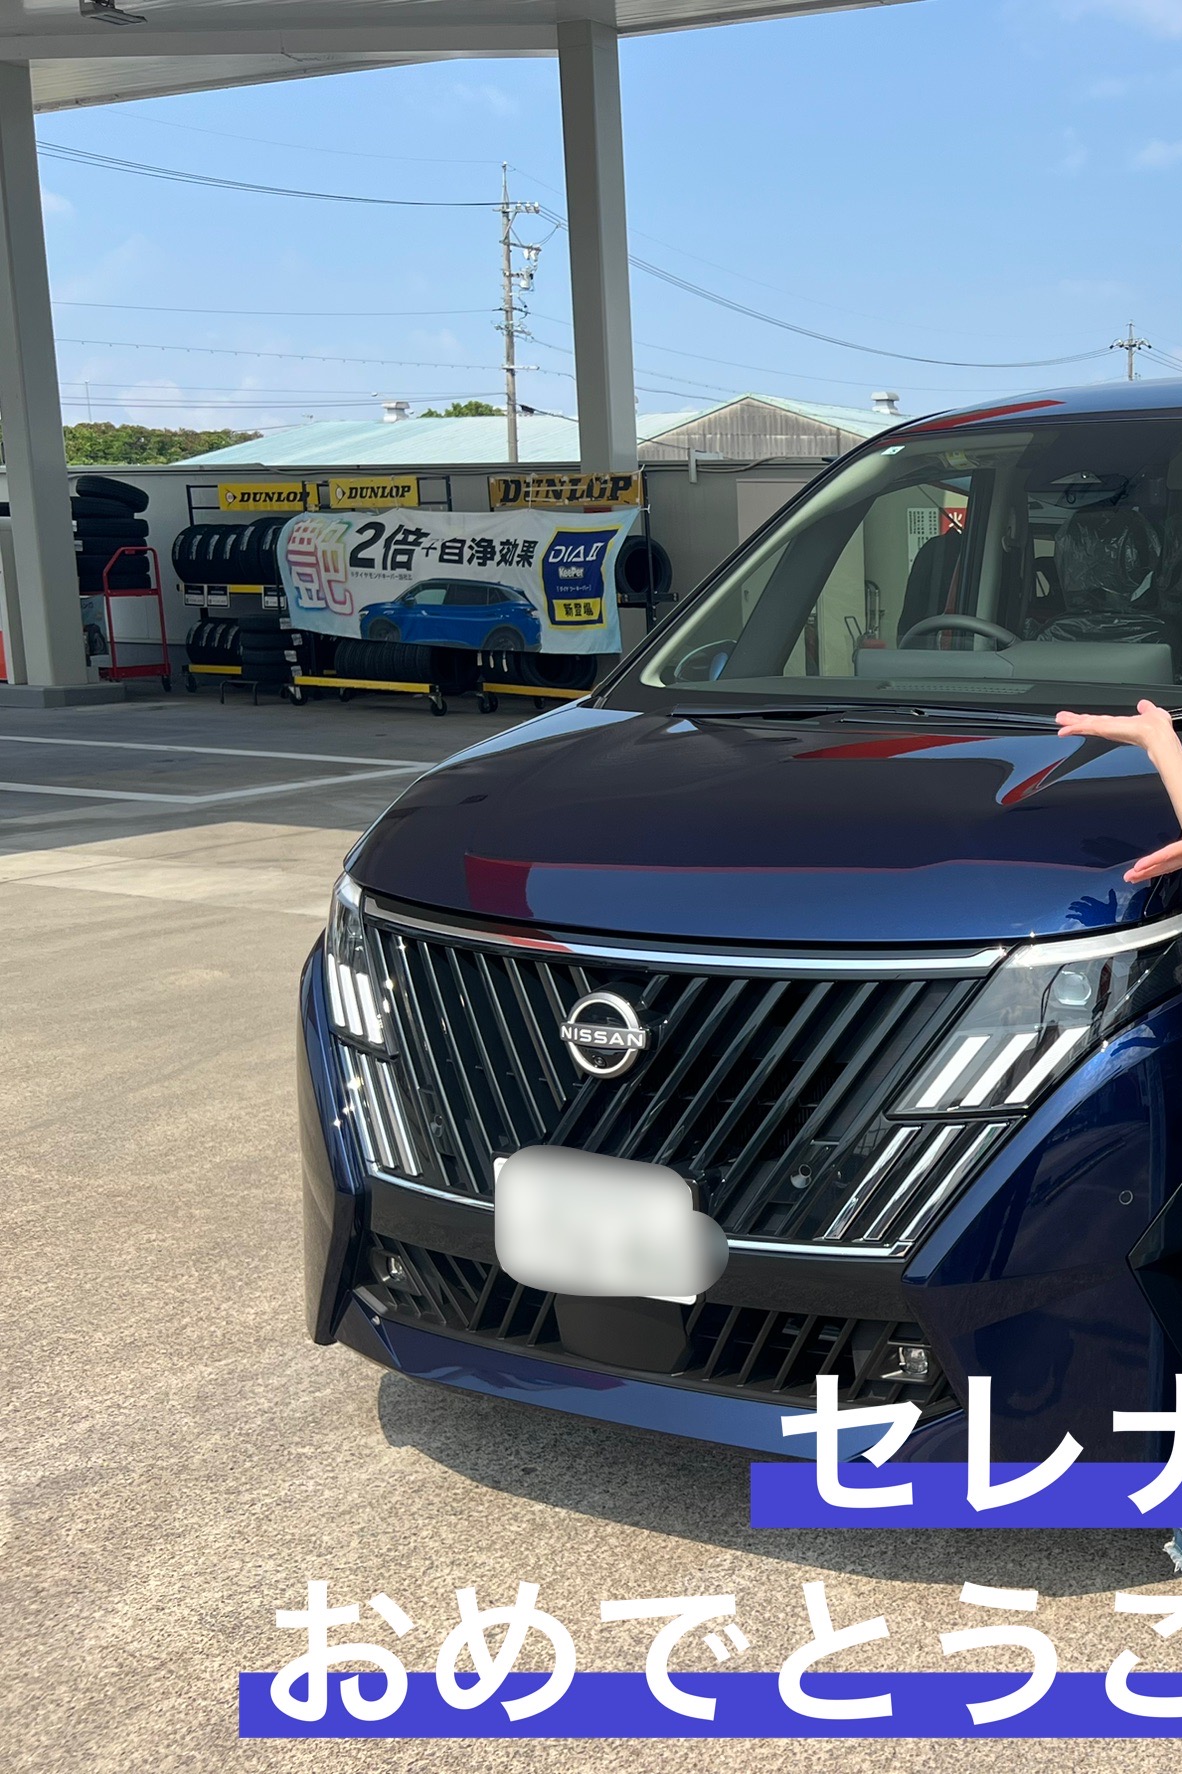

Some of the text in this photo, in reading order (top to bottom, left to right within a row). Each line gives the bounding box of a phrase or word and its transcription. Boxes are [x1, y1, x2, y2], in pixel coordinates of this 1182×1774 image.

[347, 484, 412, 500] DUNLOP
[500, 476, 632, 503] DUNLOP
[563, 602, 594, 617] 新登場
[561, 1025, 643, 1047] NISSAN
